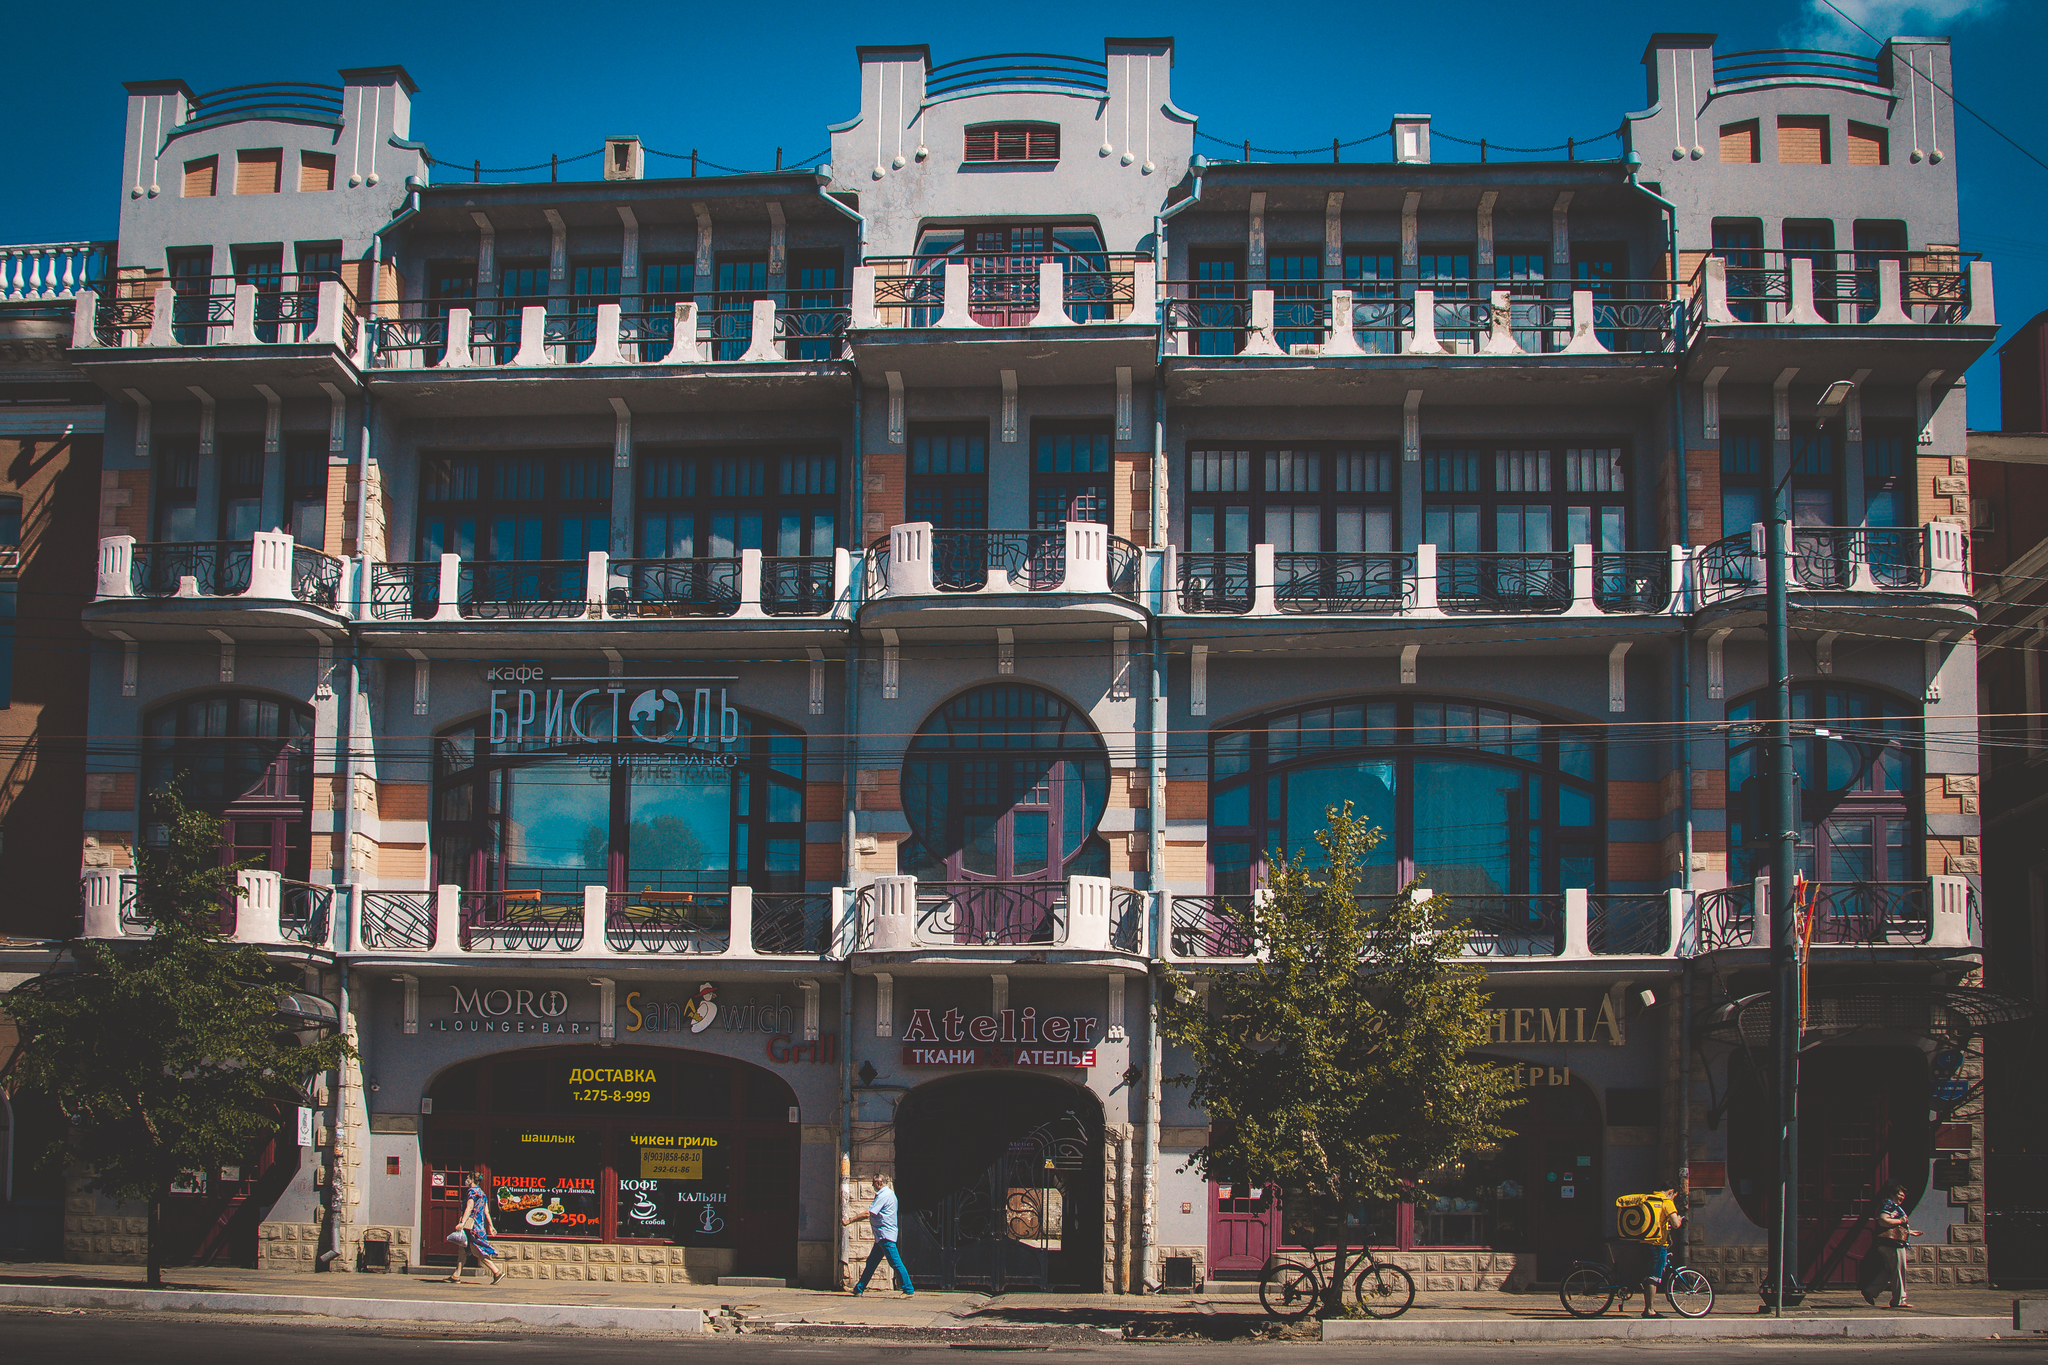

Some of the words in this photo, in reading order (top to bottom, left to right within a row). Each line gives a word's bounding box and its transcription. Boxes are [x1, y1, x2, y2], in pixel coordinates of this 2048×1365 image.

[492, 664, 544, 684] кафе
[490, 688, 739, 744] БРИСТОЛЬ
[576, 753, 612, 768] еда
[663, 753, 738, 768] только
[450, 985, 568, 1019] MORO
[440, 1020, 525, 1033] LOUNGE
[903, 1007, 1097, 1043] Atelier
[766, 1035, 834, 1064] Grill
[913, 1049, 975, 1064] ТКАНИ
[1017, 1050, 1093, 1065] АТЕЛЬЕ
[569, 1069, 656, 1084] ДОСТАВКА
[573, 1090, 650, 1102] т.275-8-999
[521, 1134, 575, 1143] шашлык
[630, 1135, 674, 1145] чикен
[678, 1136, 718, 1148] гриль
[643, 1152, 700, 1163] 8(903)858-68-10
[492, 1176, 546, 1188] БИЗНЕС
[556, 1178, 595, 1189] ЛАНЧ
[620, 1180, 658, 1191] КОФЕ
[678, 1192, 727, 1202] КАЛЬЯН
[560, 1213, 586, 1227] 250
